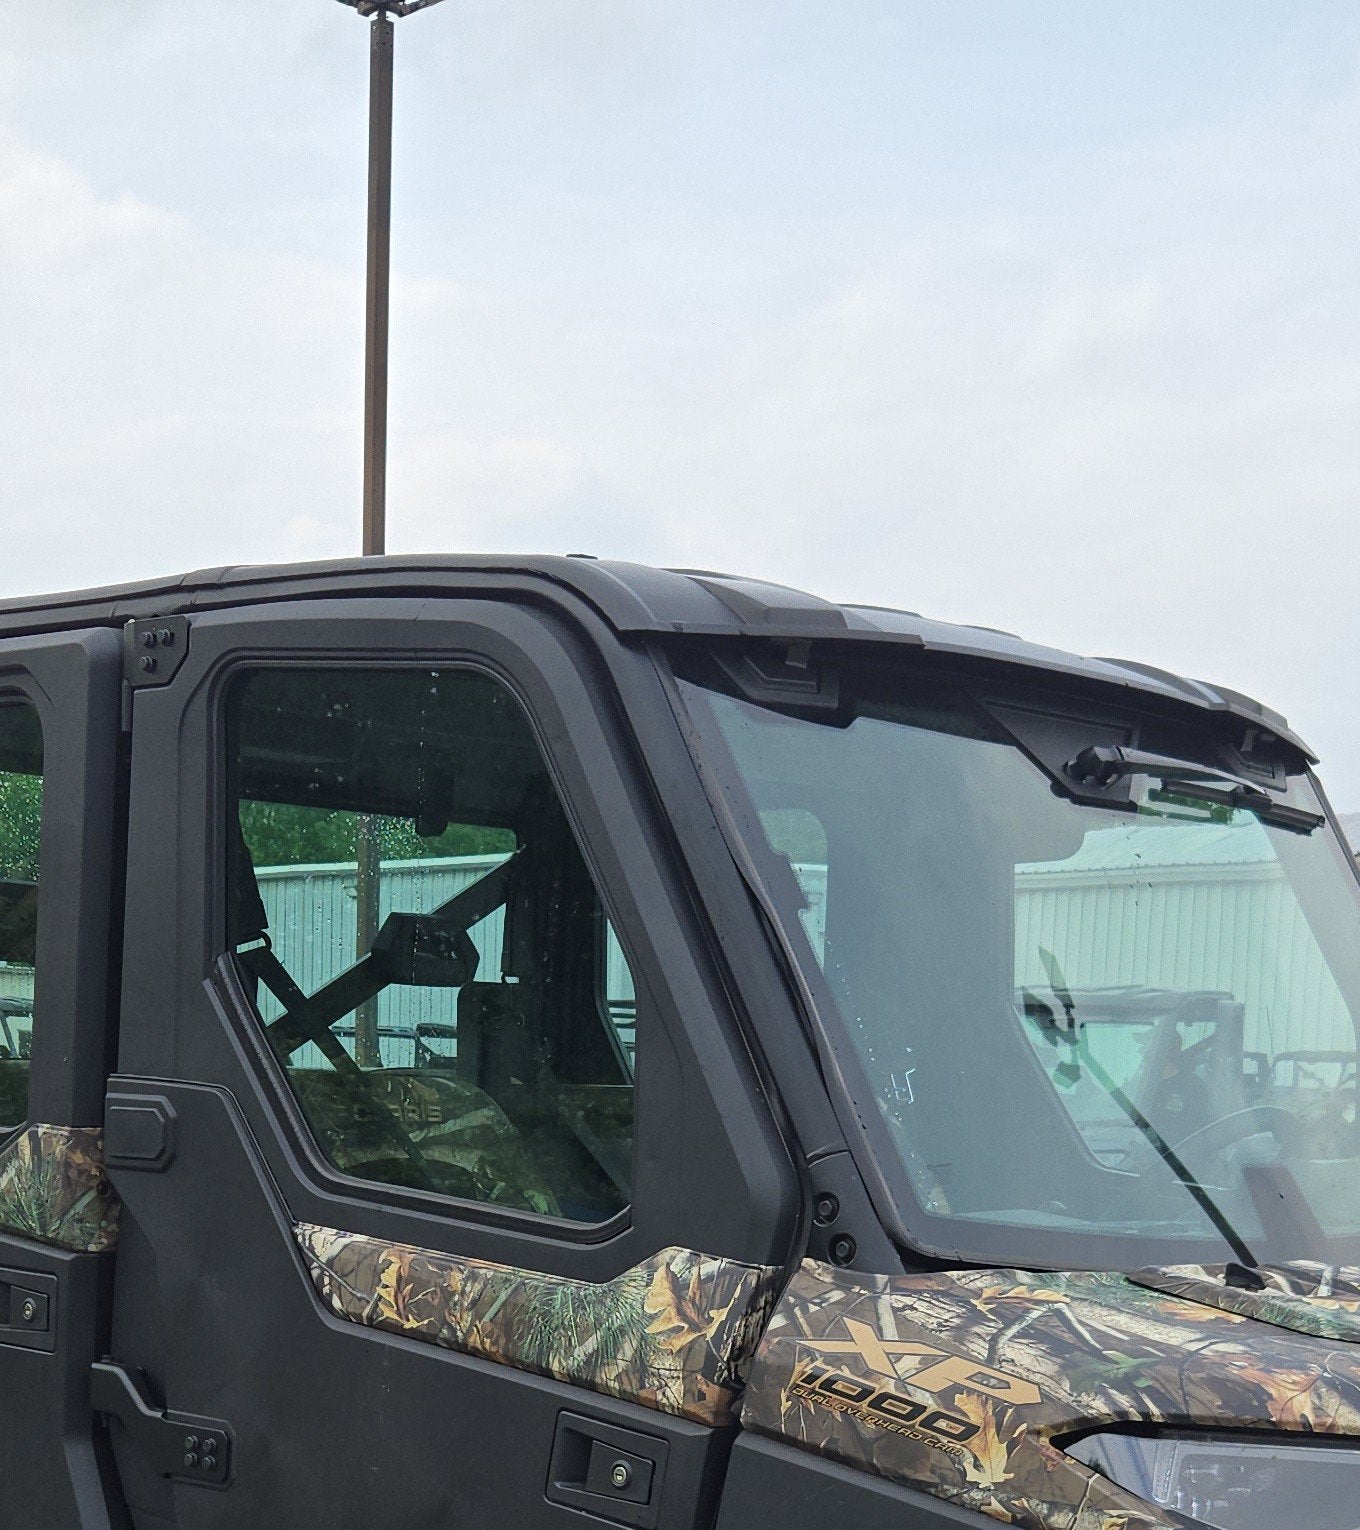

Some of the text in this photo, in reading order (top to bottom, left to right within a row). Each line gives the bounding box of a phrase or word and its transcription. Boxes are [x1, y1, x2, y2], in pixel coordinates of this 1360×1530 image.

[795, 1315, 1042, 1405] XP
[791, 1386, 965, 1457] DUAL OVERHEAD CAM
[796, 1362, 982, 1443] 1000
